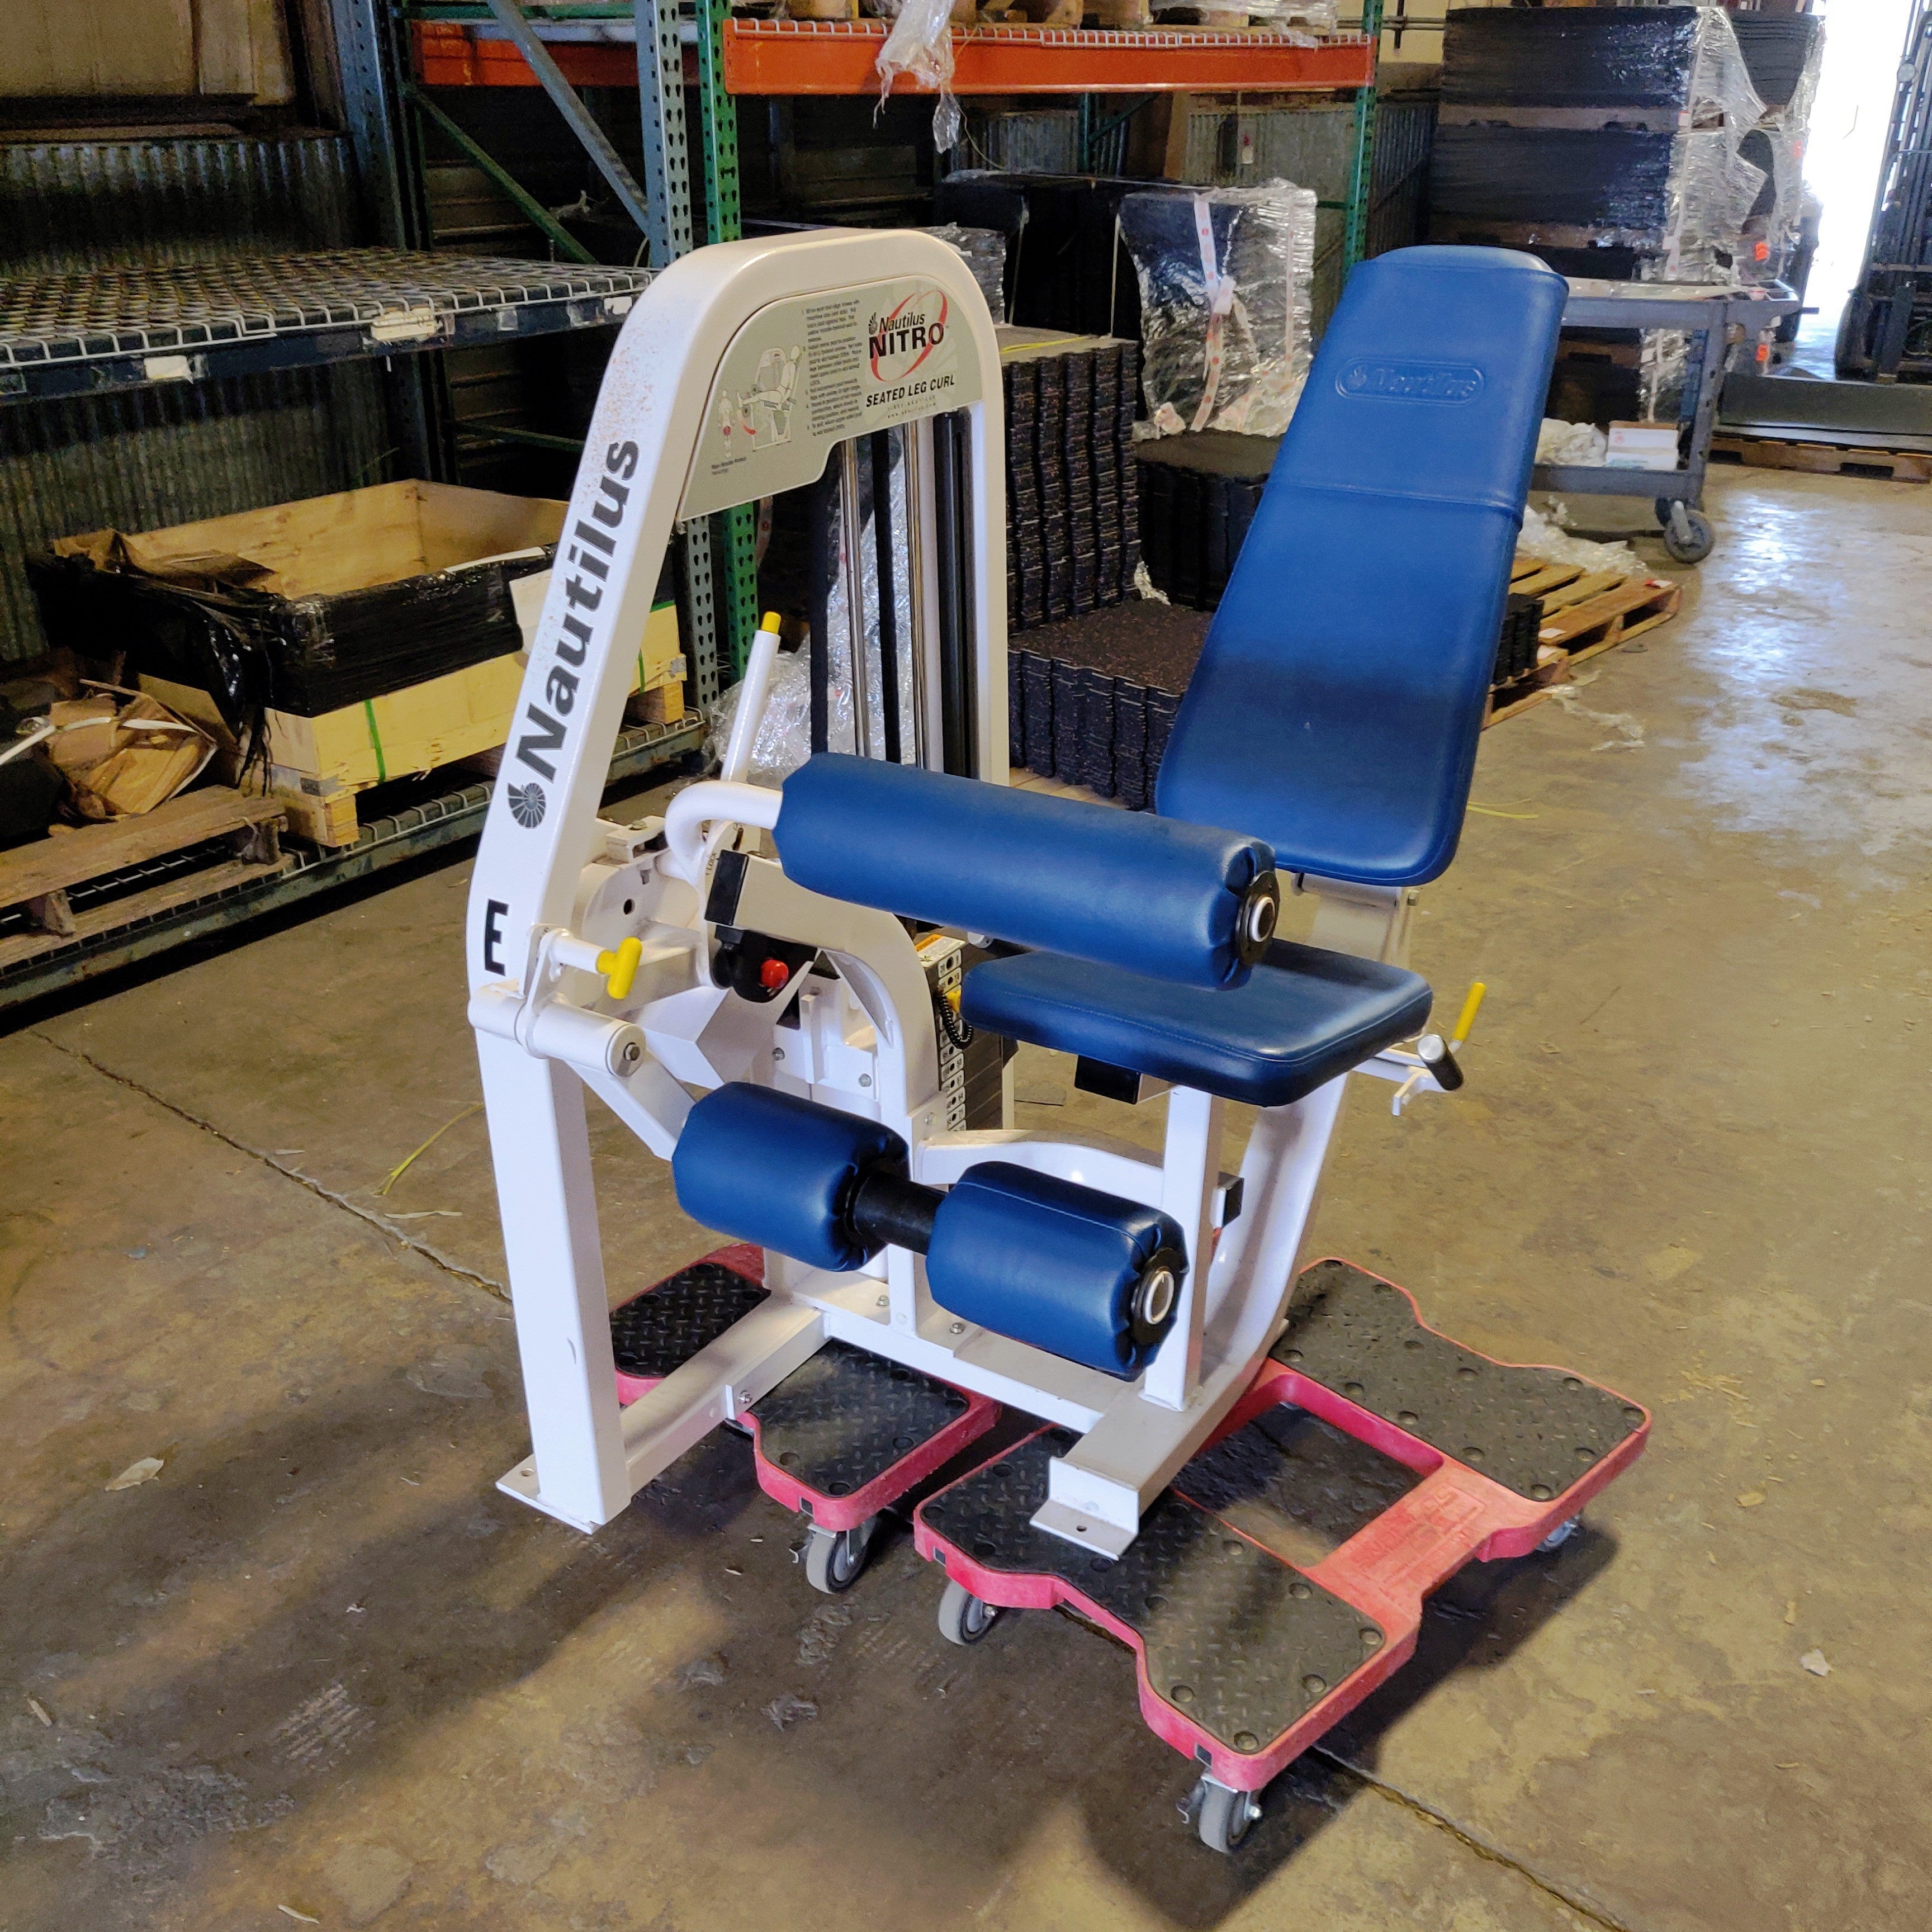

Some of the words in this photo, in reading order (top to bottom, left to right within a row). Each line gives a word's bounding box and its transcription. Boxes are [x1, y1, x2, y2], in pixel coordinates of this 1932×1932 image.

[879, 311, 925, 333] Nautilus
[869, 323, 944, 359] NITRO
[866, 387, 905, 408] SEATED
[908, 381, 927, 396] LEG
[930, 374, 955, 391] CURL
[515, 440, 640, 783] Nautilus
[484, 898, 509, 977] E
